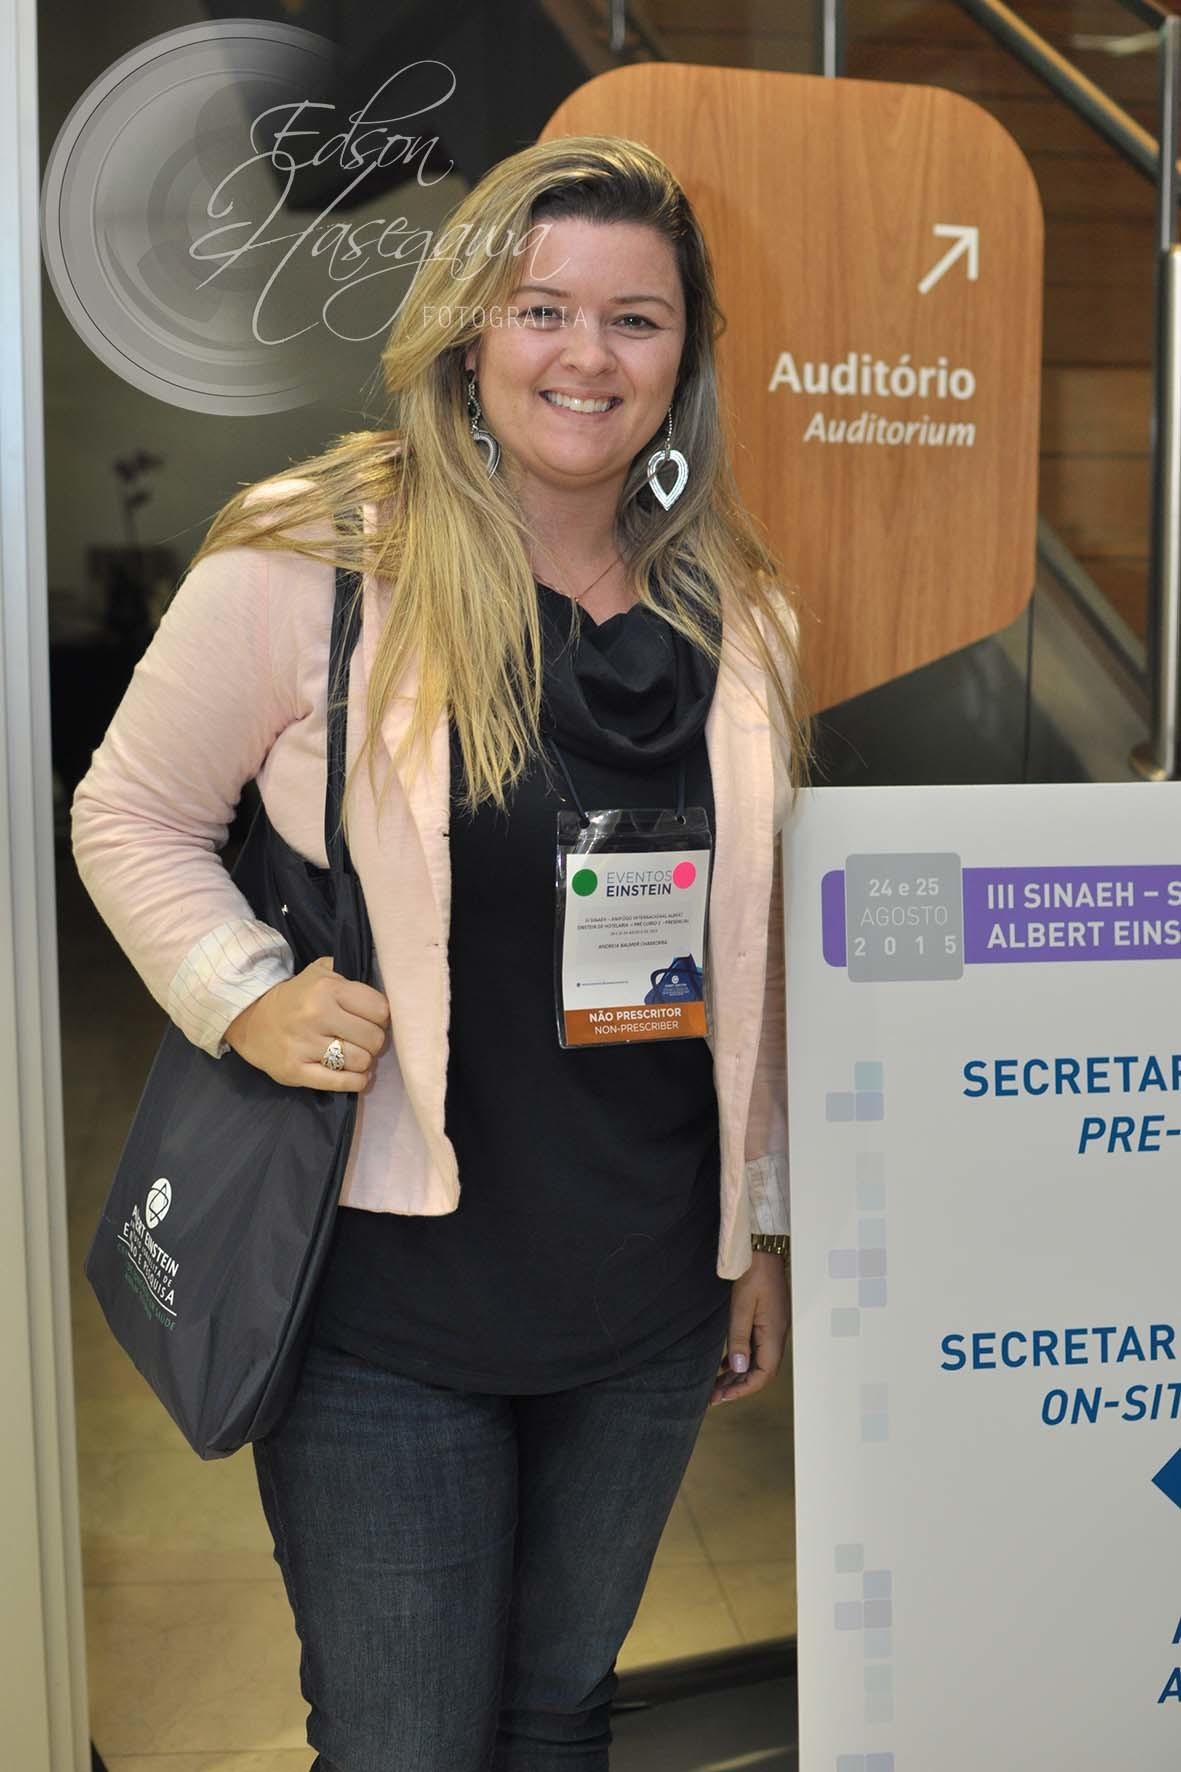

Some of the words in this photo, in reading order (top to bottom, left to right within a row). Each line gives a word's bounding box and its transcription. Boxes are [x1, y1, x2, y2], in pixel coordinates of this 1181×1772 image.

[768, 351, 976, 399] Auditório
[803, 411, 976, 447] Auditorium
[607, 870, 672, 884] EVENTOS
[869, 879, 893, 897] 24
[898, 882, 910, 896] e
[916, 878, 939, 896] 25
[606, 883, 672, 897] EINSTEIN
[987, 883, 1014, 909] III
[1023, 881, 1134, 909] SINAEH
[860, 905, 948, 927] AGOSTO
[986, 920, 1104, 949] ALBERT
[1113, 919, 1181, 947] EINS
[589, 1010, 614, 1023] NÃO
[616, 1007, 682, 1021] PRESCRITOR
[595, 1020, 679, 1035] NON-PRESCRIBER
[1077, 1114, 1181, 1155] PRE-
[940, 1323, 1176, 1372] SECRETAR
